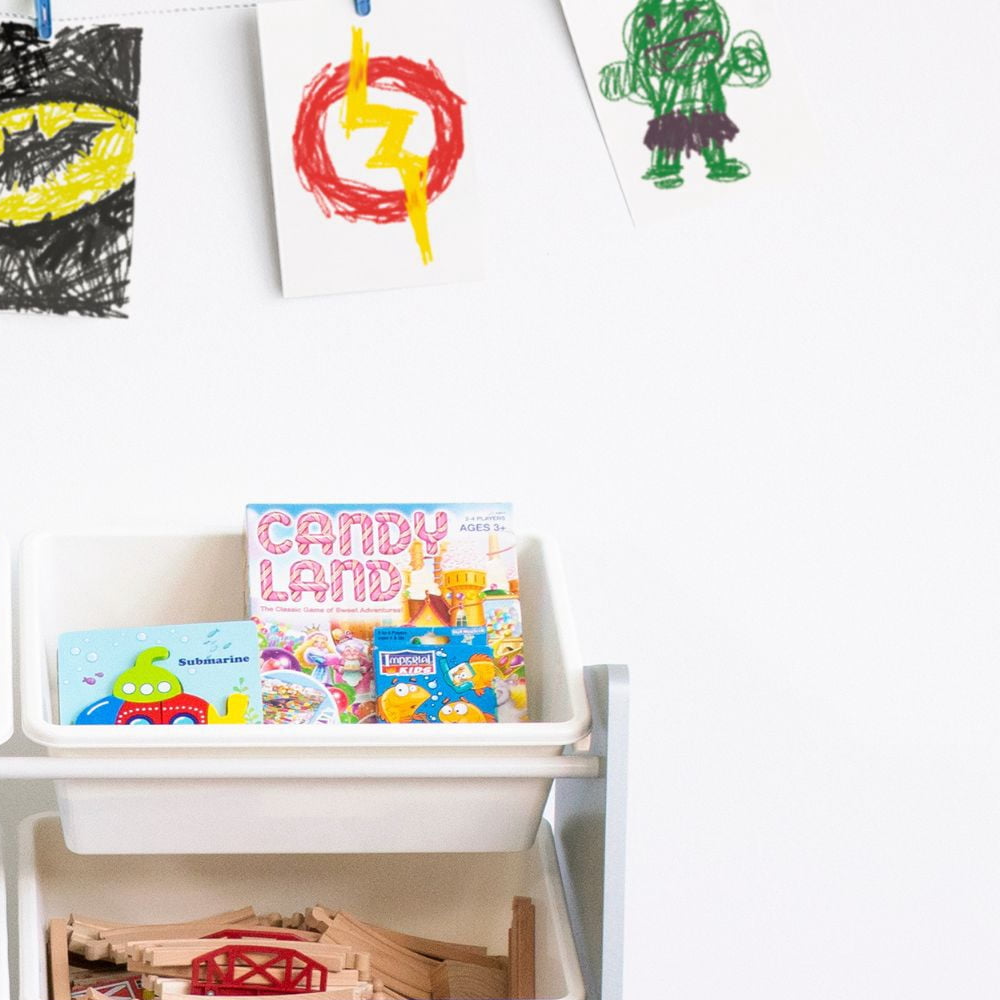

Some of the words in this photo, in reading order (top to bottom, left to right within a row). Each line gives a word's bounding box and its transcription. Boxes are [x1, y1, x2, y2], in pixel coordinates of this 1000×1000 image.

[257, 511, 449, 556] CANDY
[460, 523, 490, 532] AGES
[493, 523, 506, 532] 3+
[259, 559, 402, 603] LAND
[275, 605, 301, 613] Classic
[178, 655, 250, 667] Submarine
